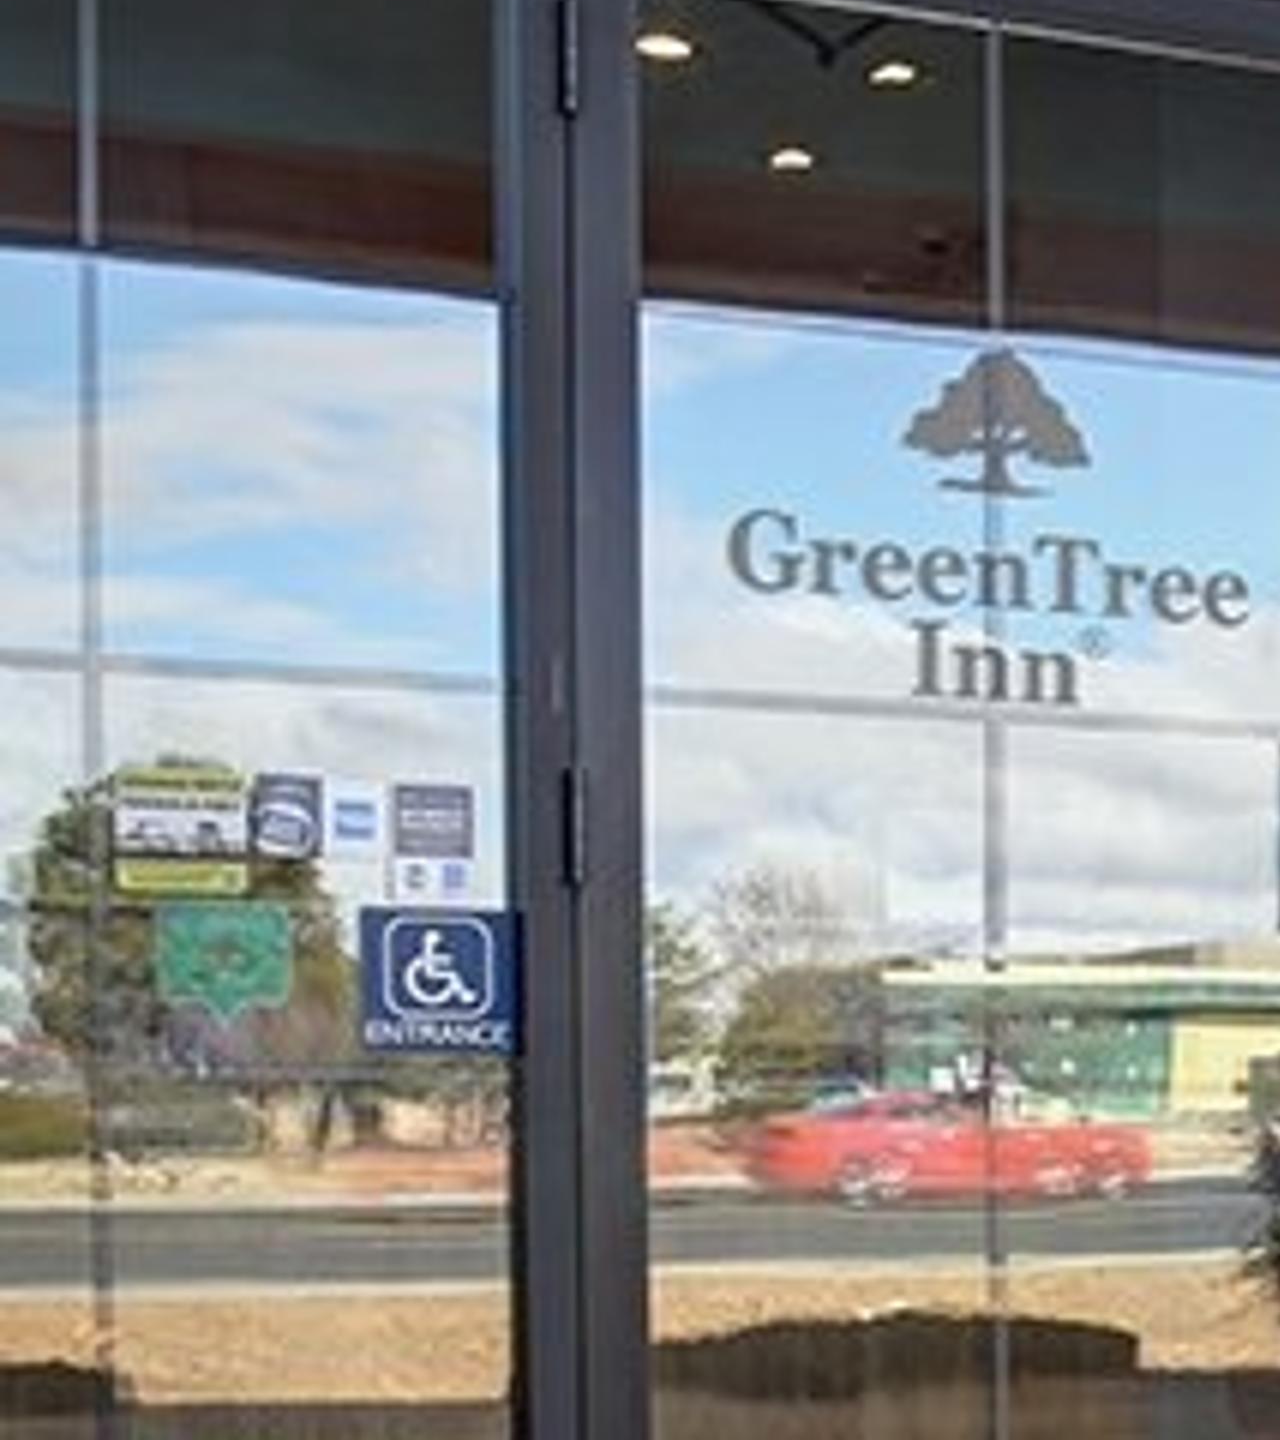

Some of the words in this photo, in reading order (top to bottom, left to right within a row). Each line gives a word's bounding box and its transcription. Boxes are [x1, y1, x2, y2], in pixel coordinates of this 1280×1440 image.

[727, 508, 1250, 627] GreenTree
[910, 618, 1079, 703] Inn
[364, 1020, 512, 1051] ENTRANCE
